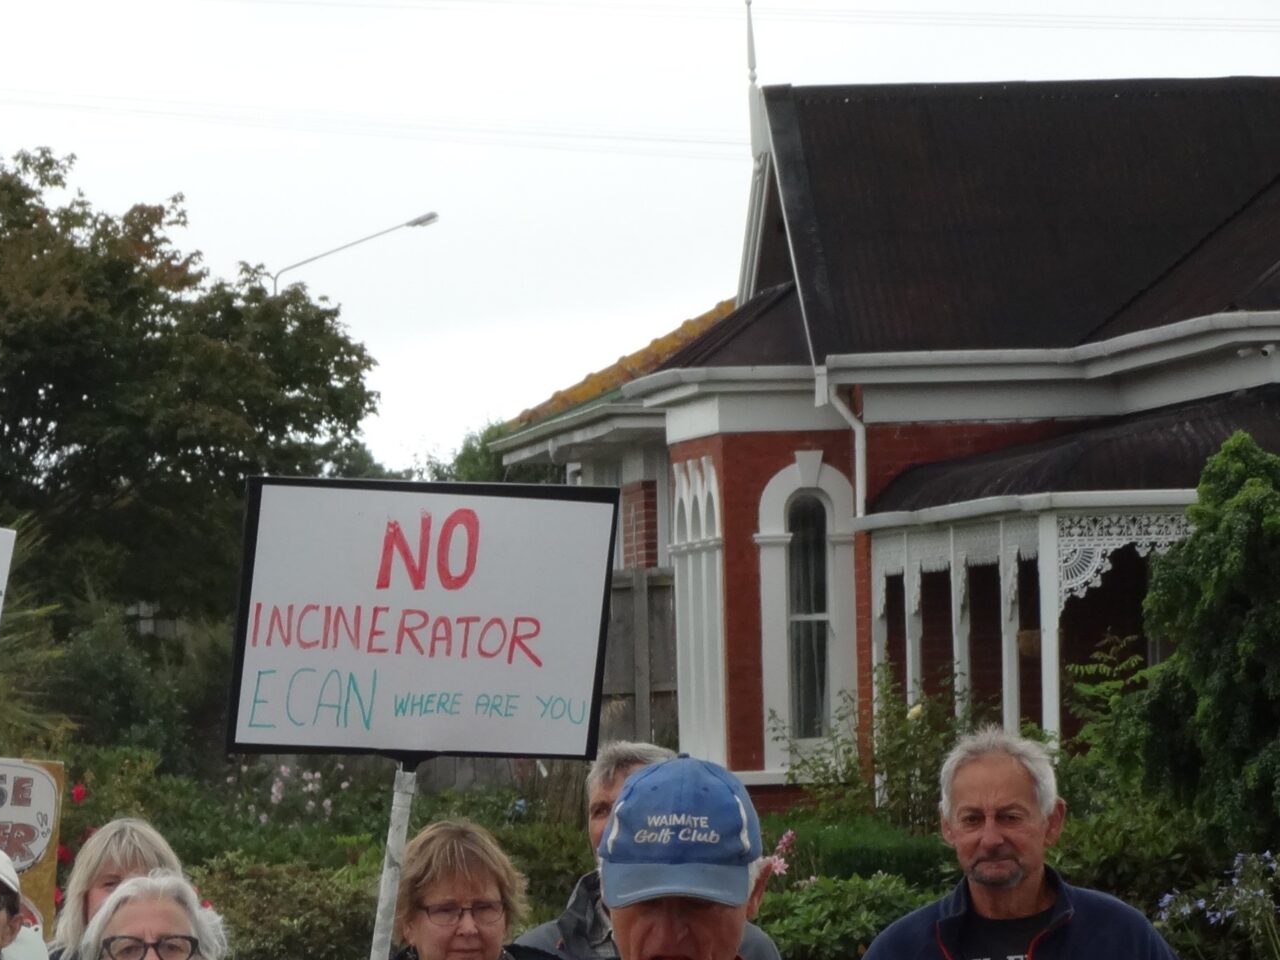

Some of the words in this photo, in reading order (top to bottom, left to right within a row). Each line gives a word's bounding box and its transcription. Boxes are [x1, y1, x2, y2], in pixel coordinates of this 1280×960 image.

[376, 507, 480, 591] NO
[251, 602, 544, 668] INCINERATOR
[248, 667, 377, 731] ECAN
[394, 692, 464, 719] WHERE
[474, 693, 520, 719] ARE
[536, 695, 586, 726] YOU
[634, 828, 676, 844] Golf
[678, 828, 721, 845] Club
[647, 813, 710, 829] WAIMATE
